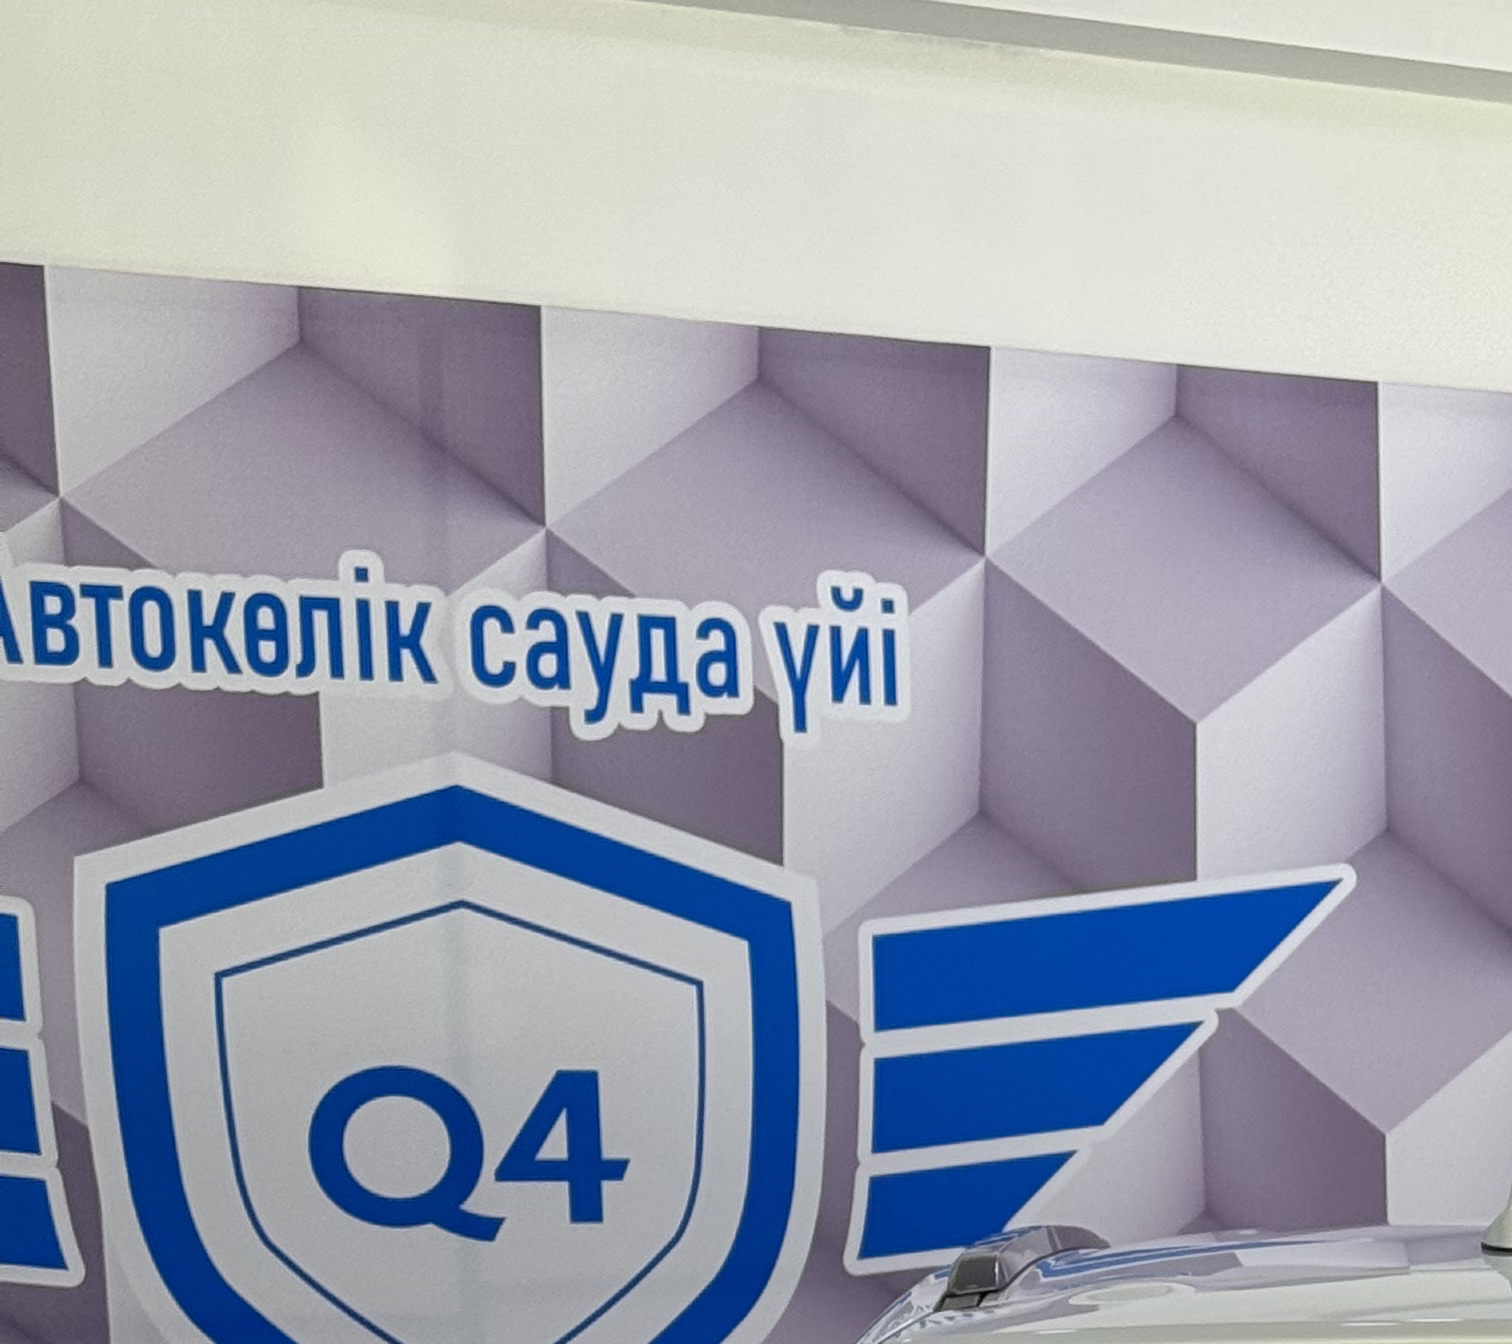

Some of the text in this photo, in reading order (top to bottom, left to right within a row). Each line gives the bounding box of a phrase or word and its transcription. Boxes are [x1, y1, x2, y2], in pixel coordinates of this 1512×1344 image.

[469, 603, 739, 725] сауда
[774, 587, 898, 733] үйі
[307, 1065, 630, 1243] Q4
